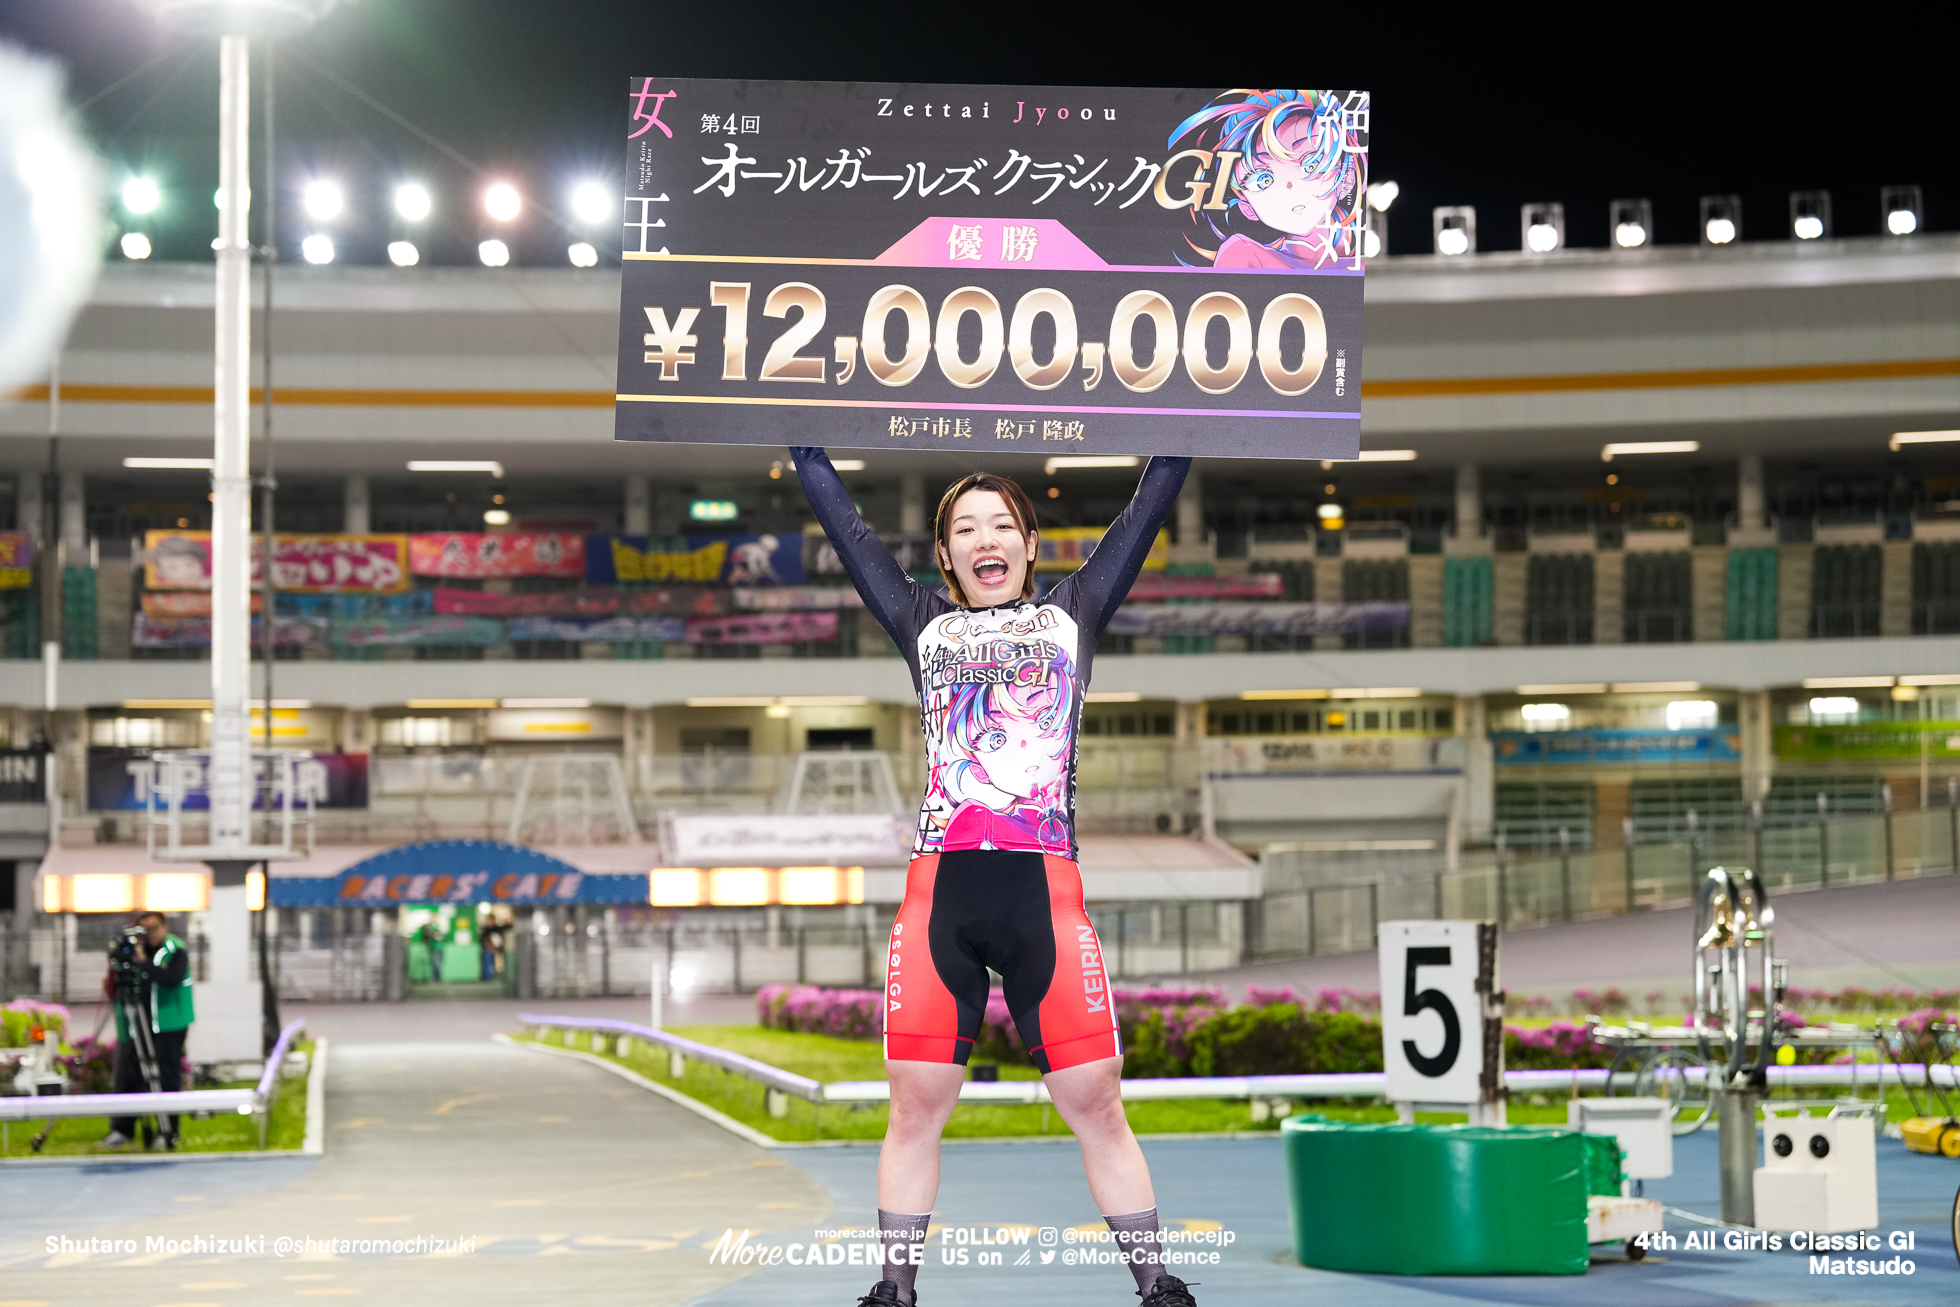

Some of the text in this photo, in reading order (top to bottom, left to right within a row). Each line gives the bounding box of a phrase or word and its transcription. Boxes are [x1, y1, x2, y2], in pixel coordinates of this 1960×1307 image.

[700, 113, 761, 135] 第4回
[877, 98, 1117, 125] Zettai Jyoou
[946, 223, 1040, 262] 優勝
[643, 281, 1328, 396] ¥12,000,000
[887, 416, 973, 439] 松戸市長
[126, 758, 329, 803] TIPAR
[1076, 925, 1107, 1013] KEIRIN
[1401, 946, 1461, 1078] 5
